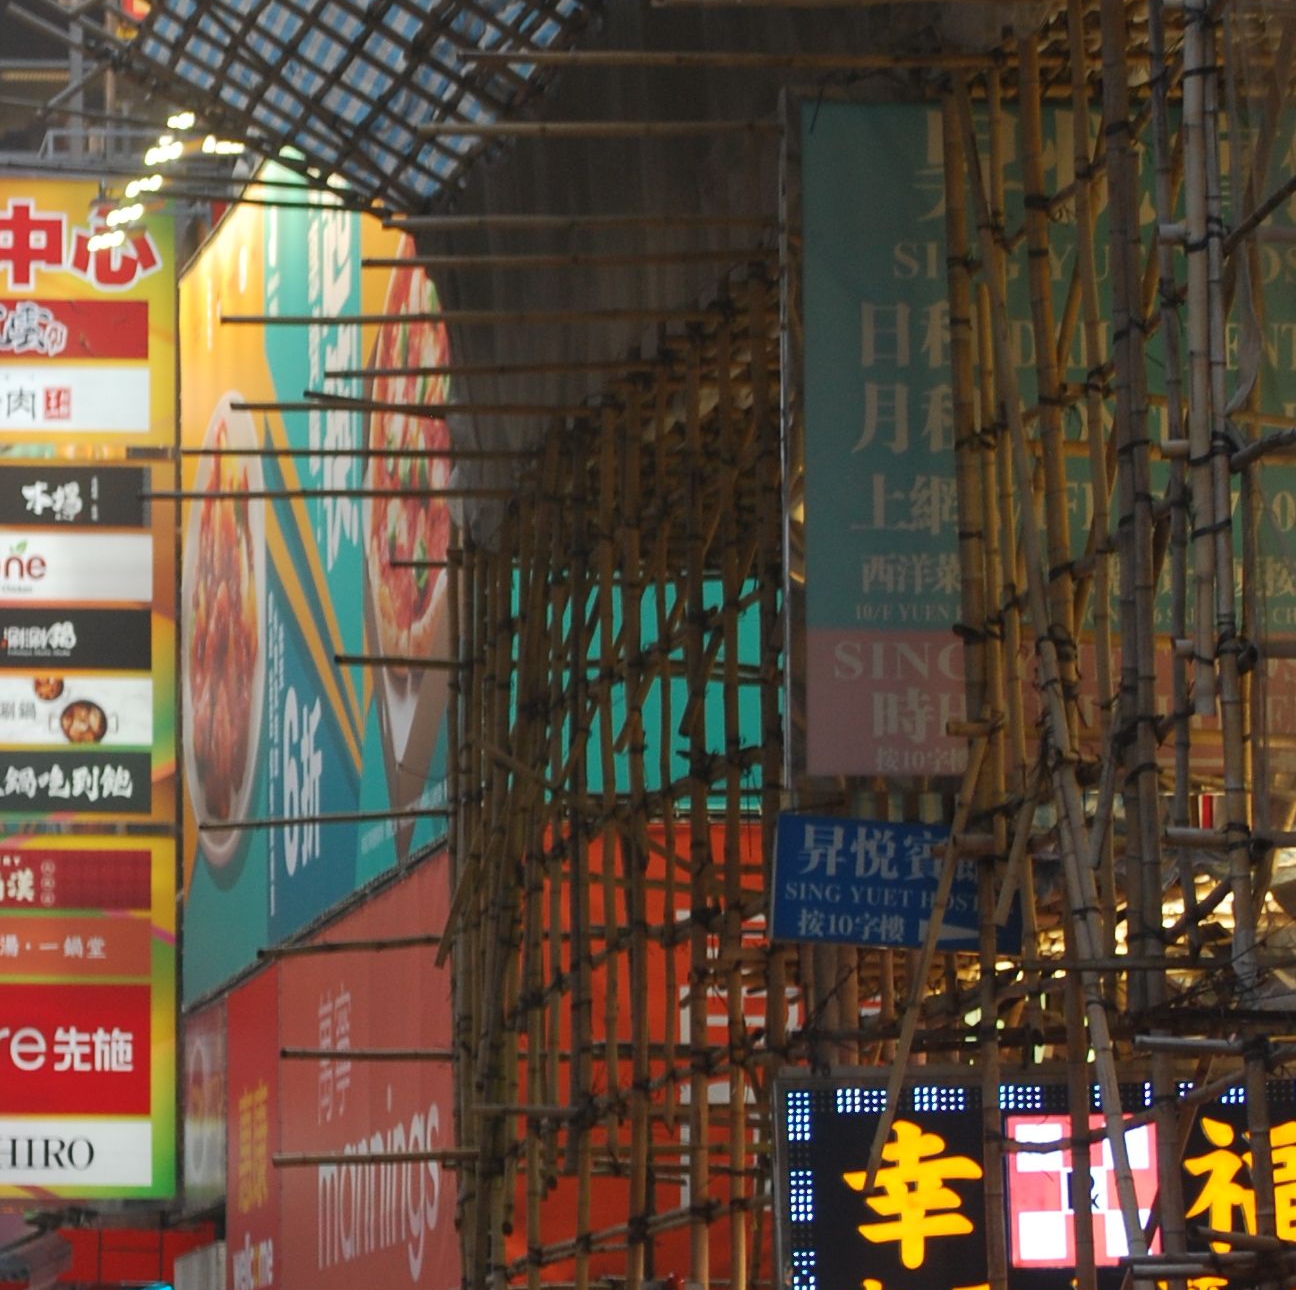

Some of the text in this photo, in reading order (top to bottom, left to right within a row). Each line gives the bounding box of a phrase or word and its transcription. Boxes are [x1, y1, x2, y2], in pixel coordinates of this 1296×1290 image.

[785, 882, 841, 902] SING
[849, 885, 914, 907] YUET
[798, 907, 905, 943] 按10字樓
[53, 1026, 134, 1073] 先施
[318, 1083, 441, 1284] mannings
